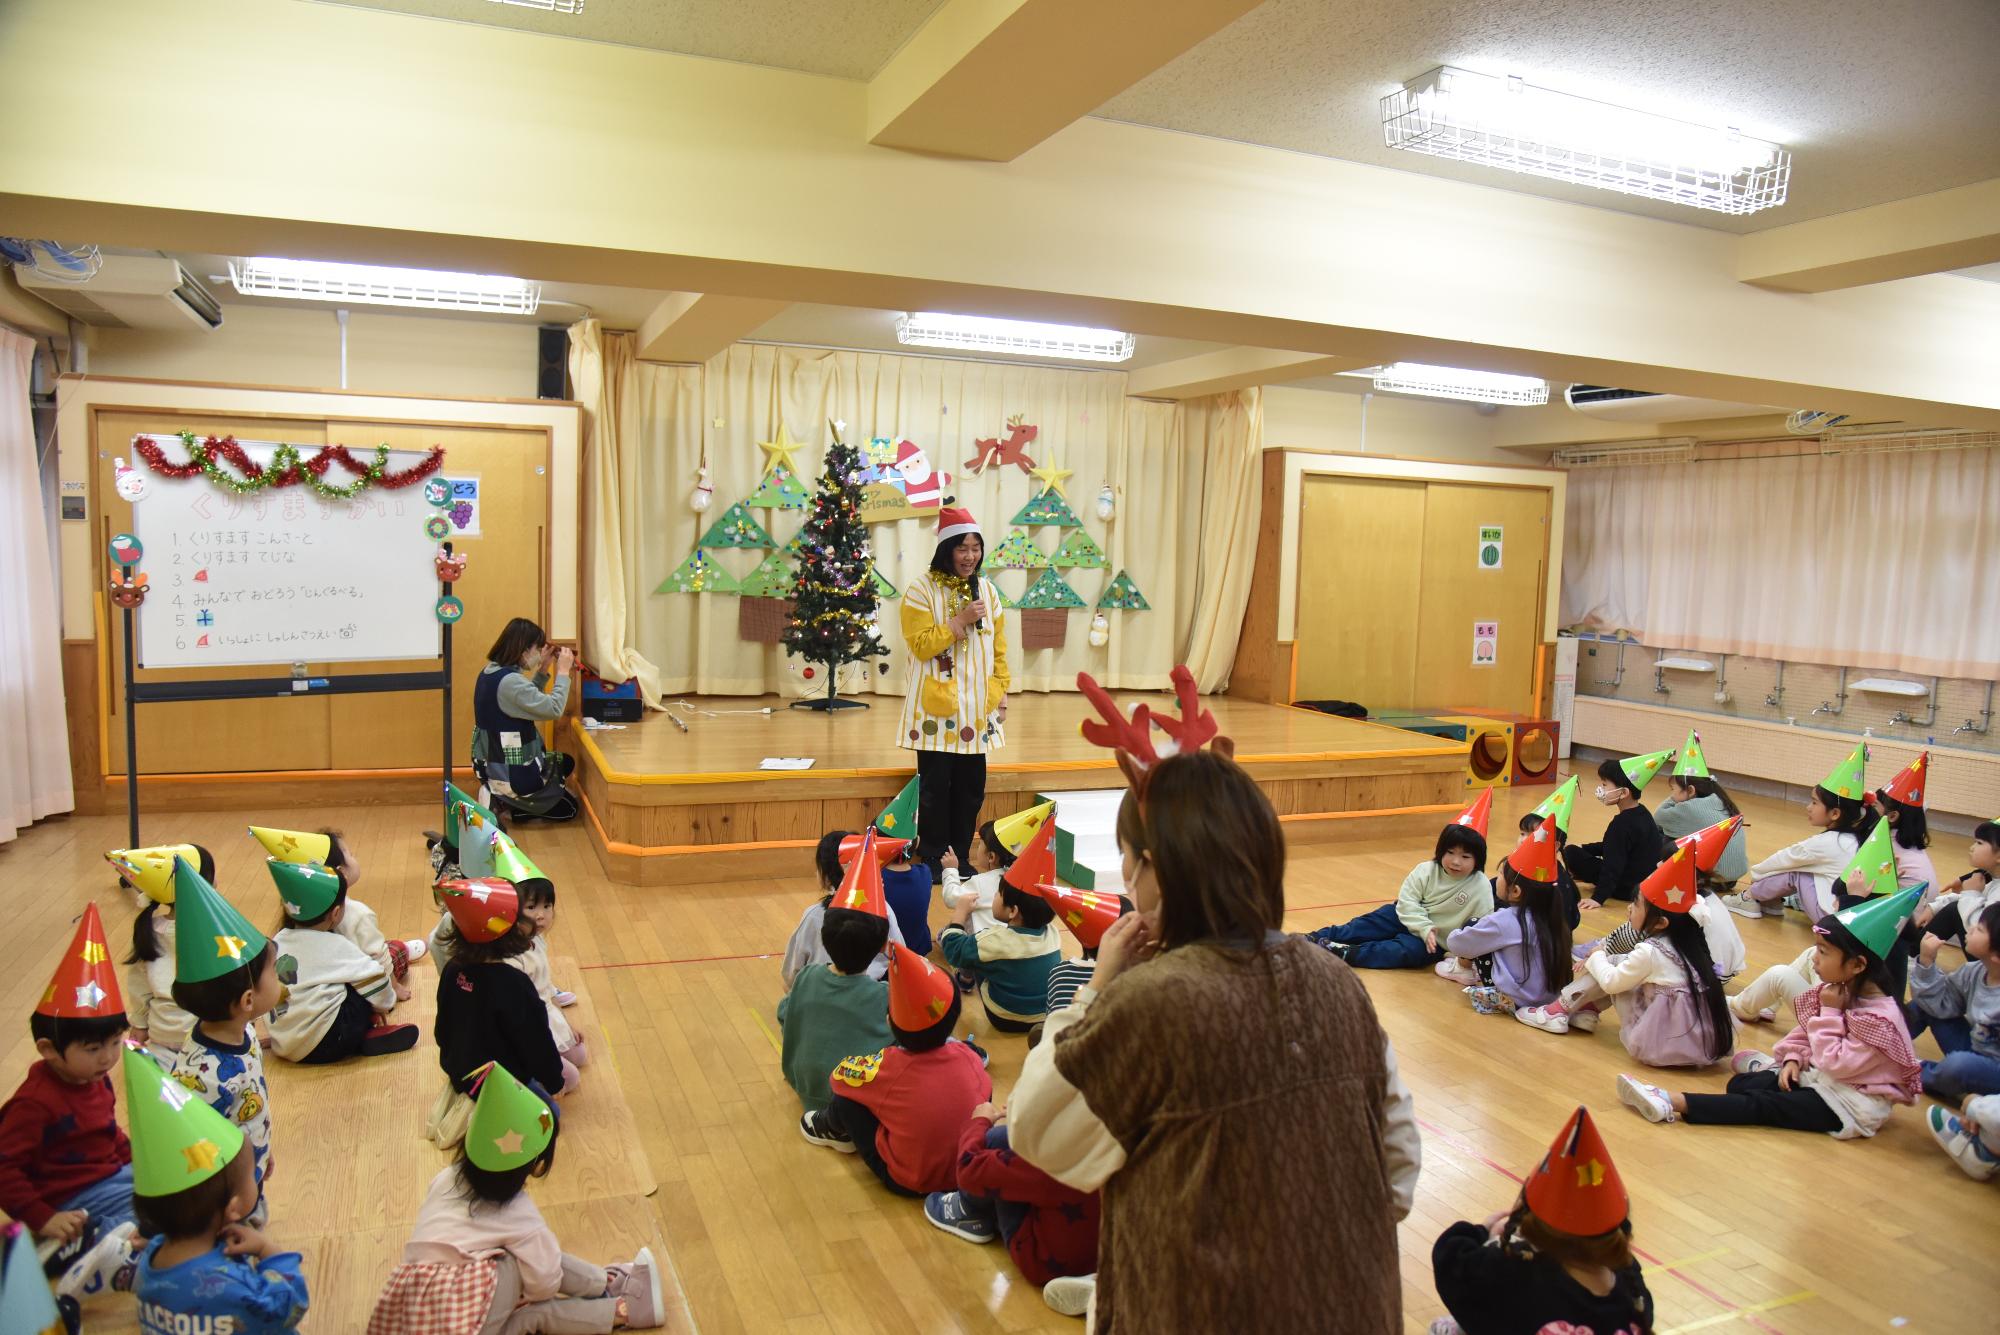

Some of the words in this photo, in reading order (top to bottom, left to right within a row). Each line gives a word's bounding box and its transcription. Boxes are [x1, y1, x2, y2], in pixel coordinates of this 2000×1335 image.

[189, 530, 251, 546] くりすます
[190, 550, 251, 567] くりすます
[258, 551, 297, 564] てじな
[193, 588, 246, 607] みんなで
[250, 587, 296, 601] おどろう
[1477, 626, 1494, 636] もも
